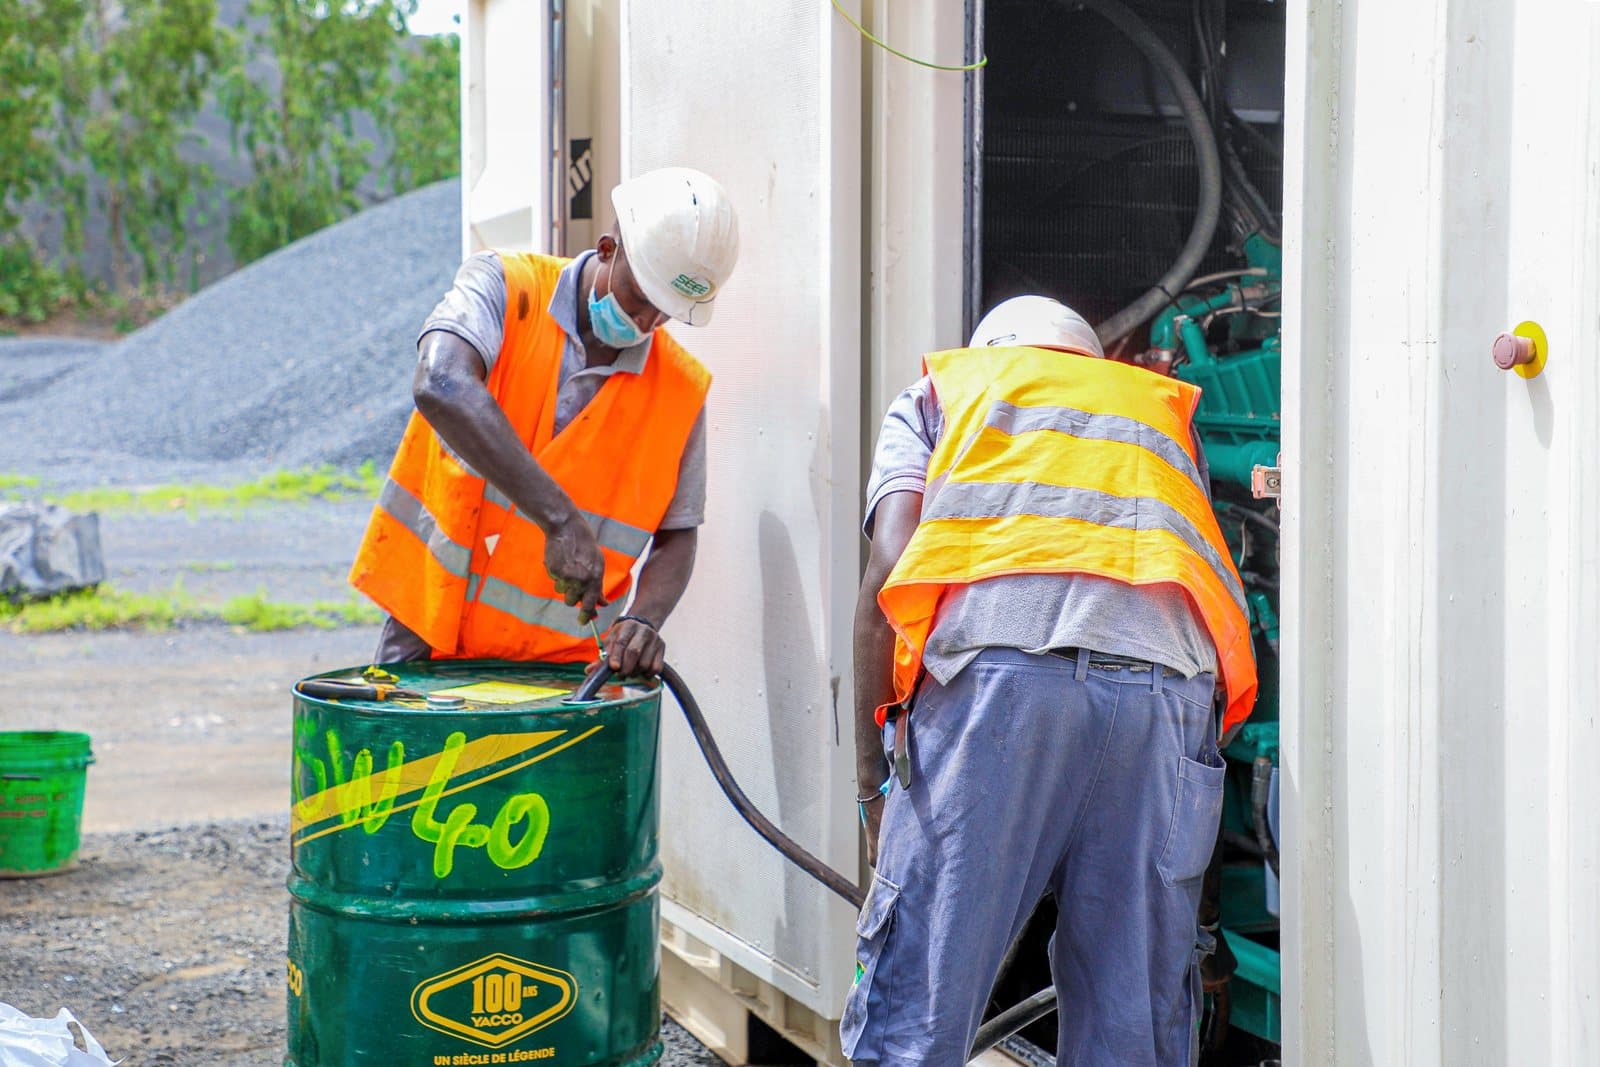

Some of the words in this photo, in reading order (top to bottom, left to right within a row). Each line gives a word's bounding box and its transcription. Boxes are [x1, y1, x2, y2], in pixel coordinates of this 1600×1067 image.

[472, 973, 521, 1013] 100
[472, 1014, 523, 1027] YACCO
[434, 1055, 450, 1066] UN
[453, 1052, 489, 1065] SIÈCLE
[492, 1052, 506, 1063] DE
[508, 1047, 555, 1062] LÉGENDE
